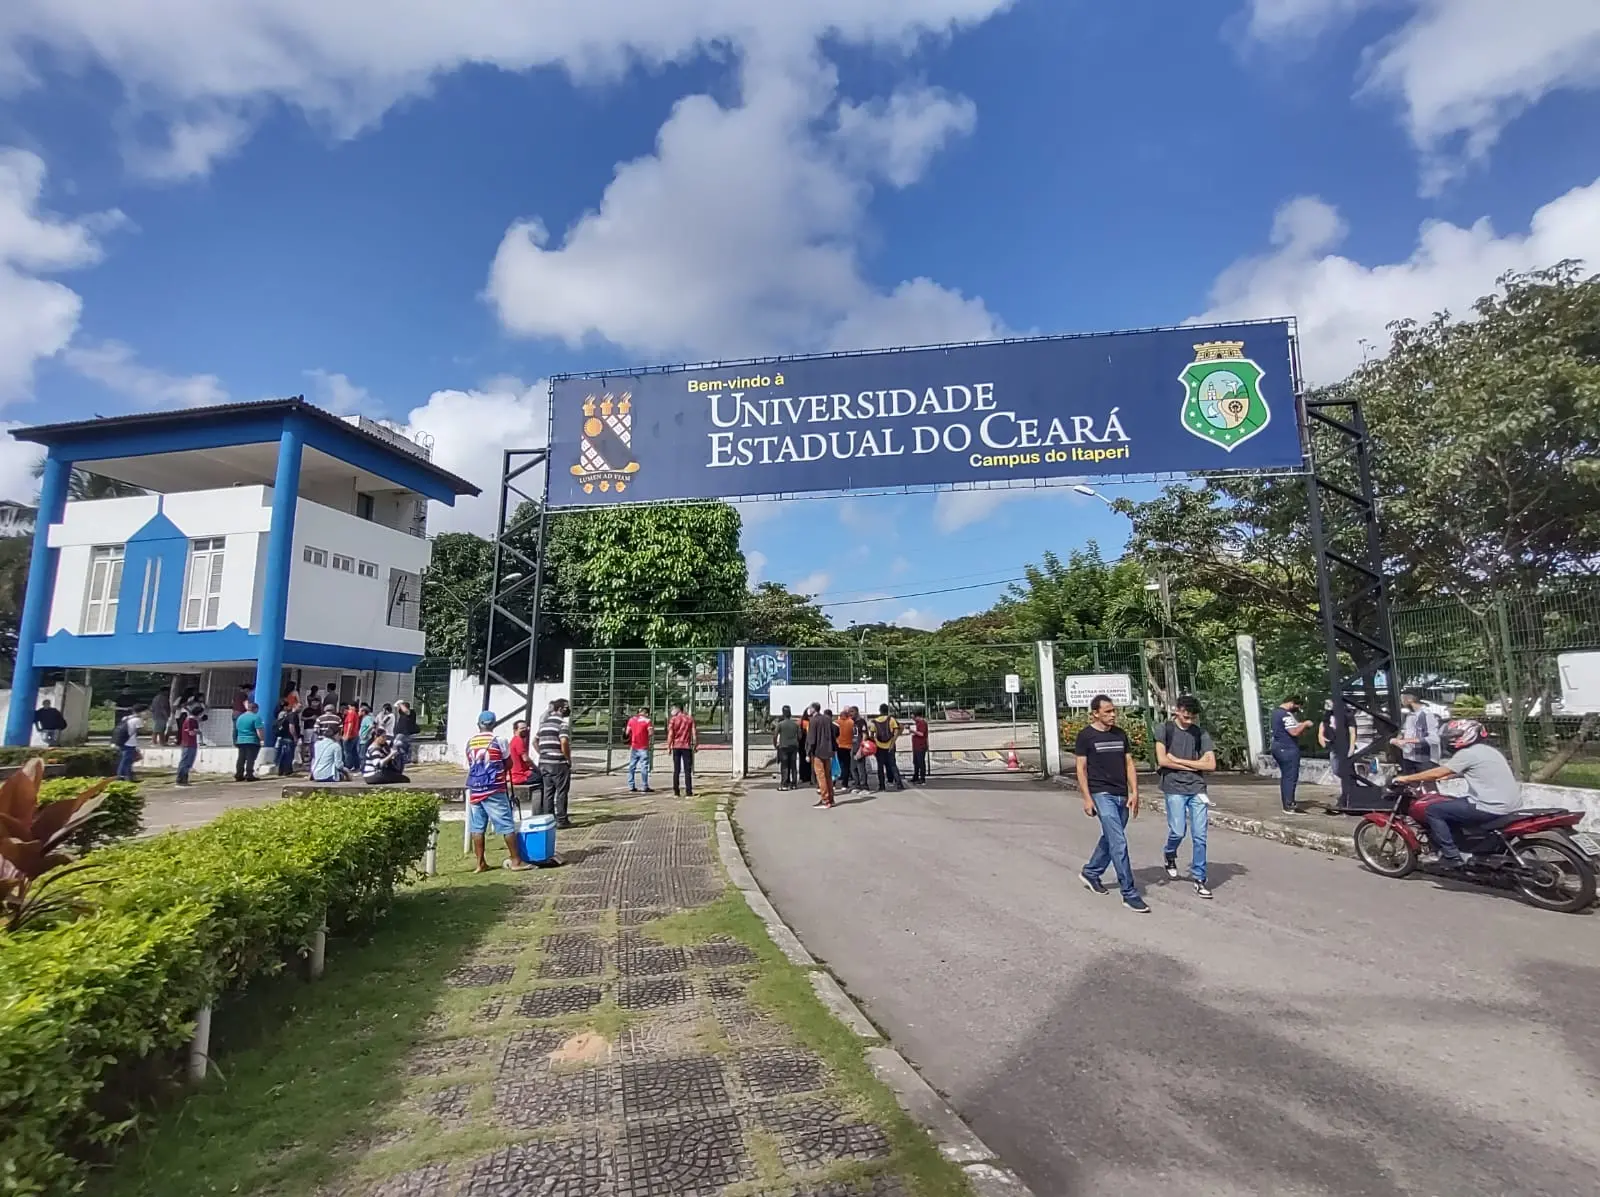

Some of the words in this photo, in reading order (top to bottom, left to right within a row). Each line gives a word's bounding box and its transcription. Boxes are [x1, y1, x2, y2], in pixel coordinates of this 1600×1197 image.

[687, 374, 771, 393] Bem-vindo
[774, 372, 785, 386] à
[707, 382, 998, 428] UNIVERSIDADE
[705, 428, 905, 468] ESTADUAL
[911, 423, 972, 454] DO
[979, 406, 1132, 449] CEARÁ
[969, 452, 1041, 468] Campus
[1044, 448, 1068, 463] do
[1071, 444, 1130, 463] Itaperi
[579, 474, 602, 484] LUMEN
[614, 473, 631, 481] VIAM
